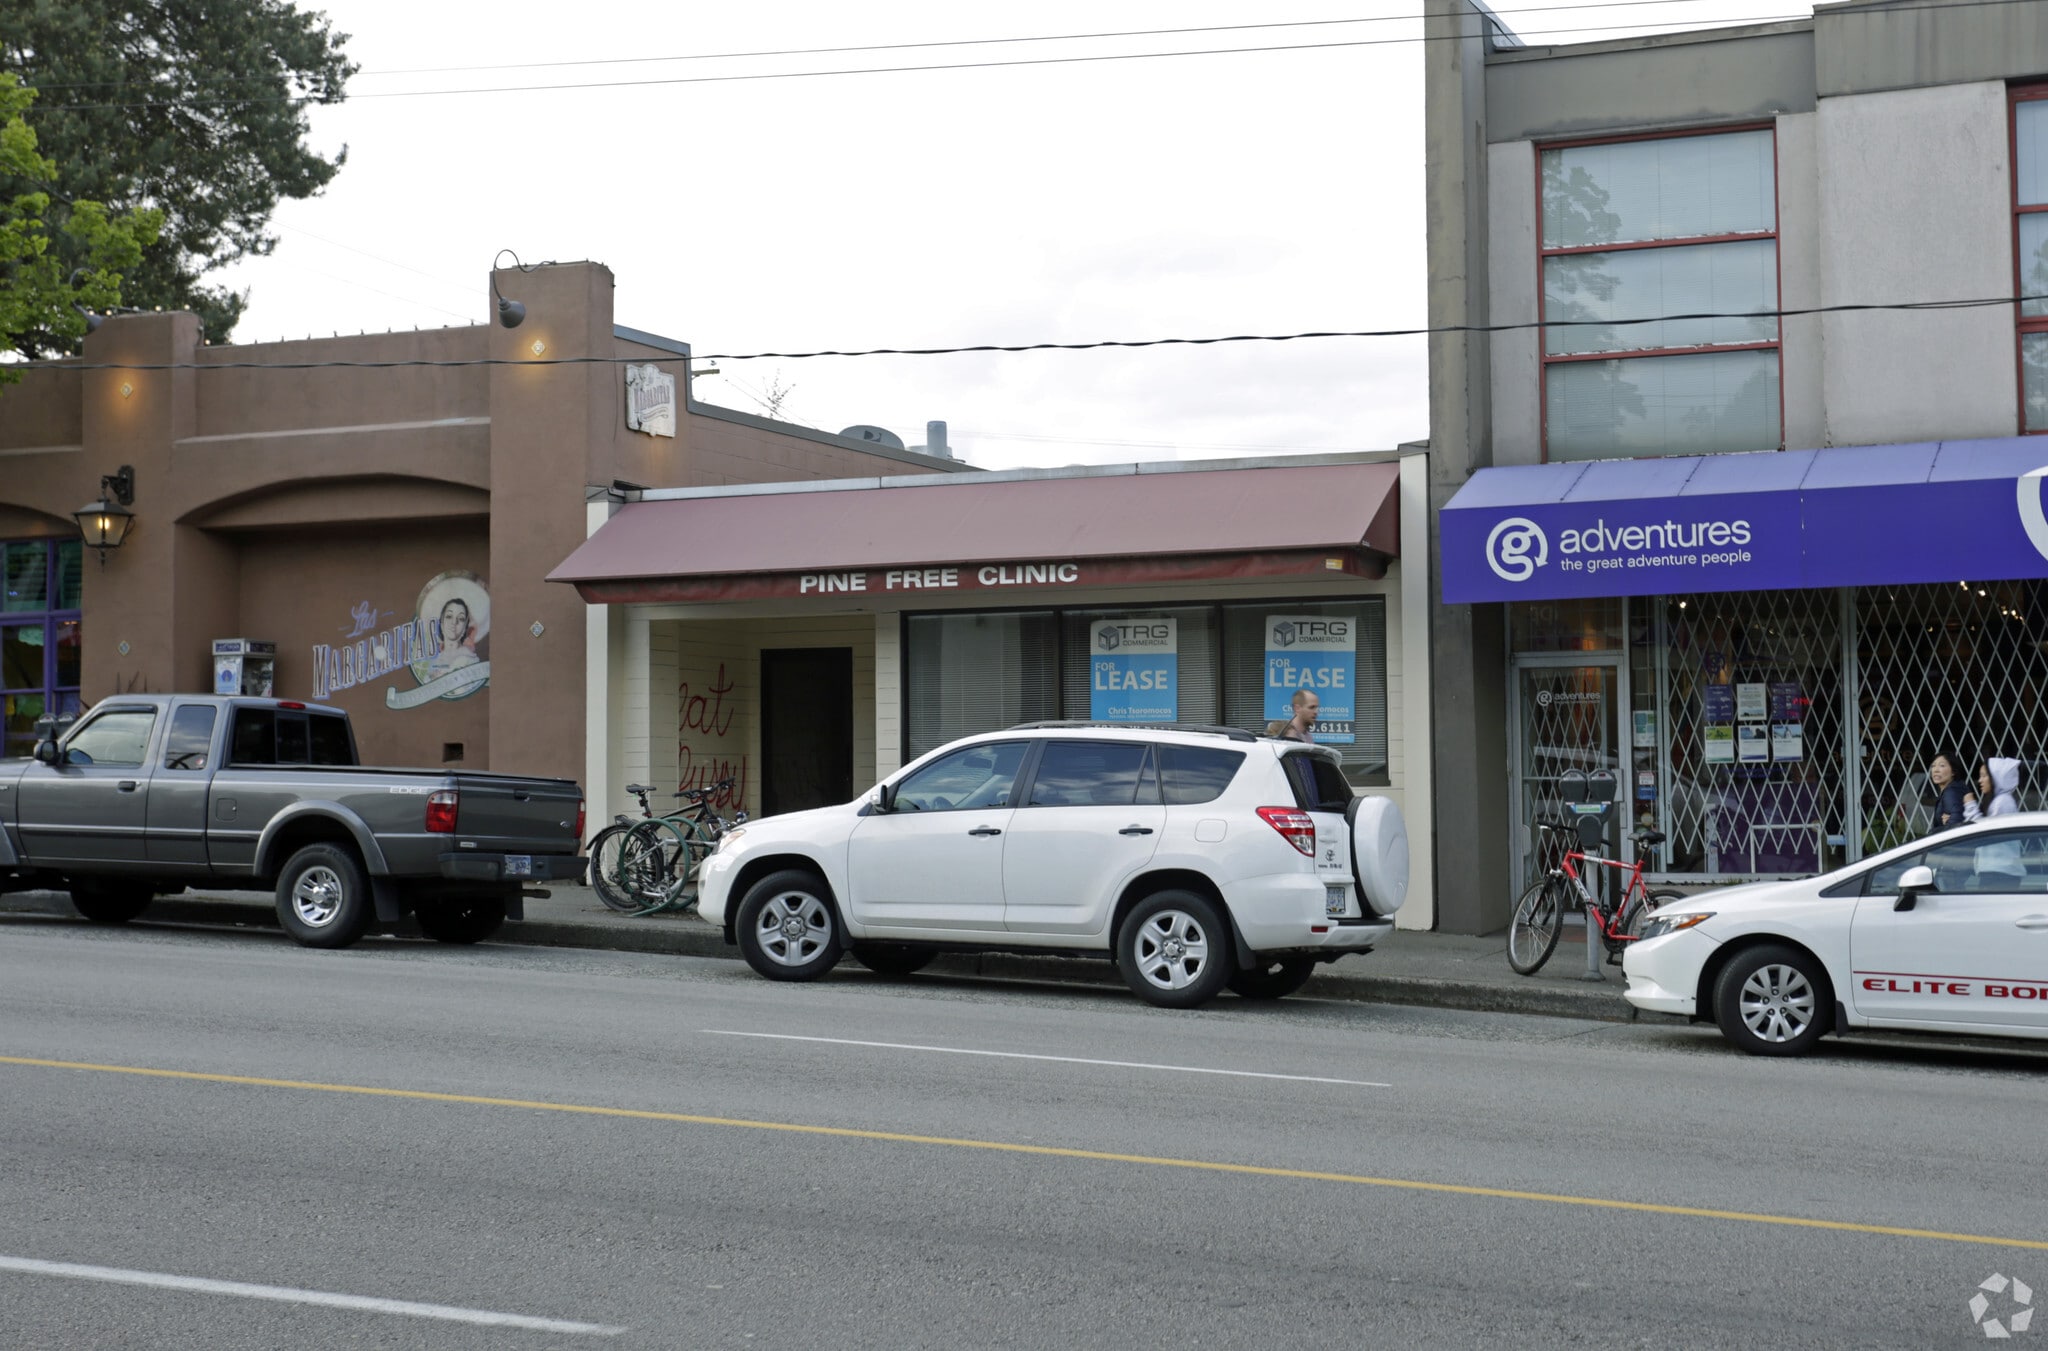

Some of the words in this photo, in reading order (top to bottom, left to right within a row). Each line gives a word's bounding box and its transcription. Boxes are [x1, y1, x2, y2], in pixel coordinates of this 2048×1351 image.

[1560, 519, 1751, 553] adventures
[1561, 558, 1583, 571] the
[1588, 556, 1623, 573] great
[1627, 553, 1697, 568] adventure
[1702, 549, 1752, 567] people
[800, 573, 867, 593] PINE
[886, 568, 958, 589] FREE
[978, 563, 1078, 585] CLINIC
[1117, 625, 1169, 639] TRG
[1293, 622, 1348, 636] TRG
[312, 616, 440, 699] MARGARITAS
[1269, 659, 1290, 667] FOR
[1095, 662, 1115, 671] FOR
[1095, 670, 1168, 690] LEASE
[1269, 667, 1345, 688] LEASE
[1108, 707, 1127, 715] Chris
[1308, 722, 1350, 733] 9.6111
[1863, 978, 1970, 995] ELITE
